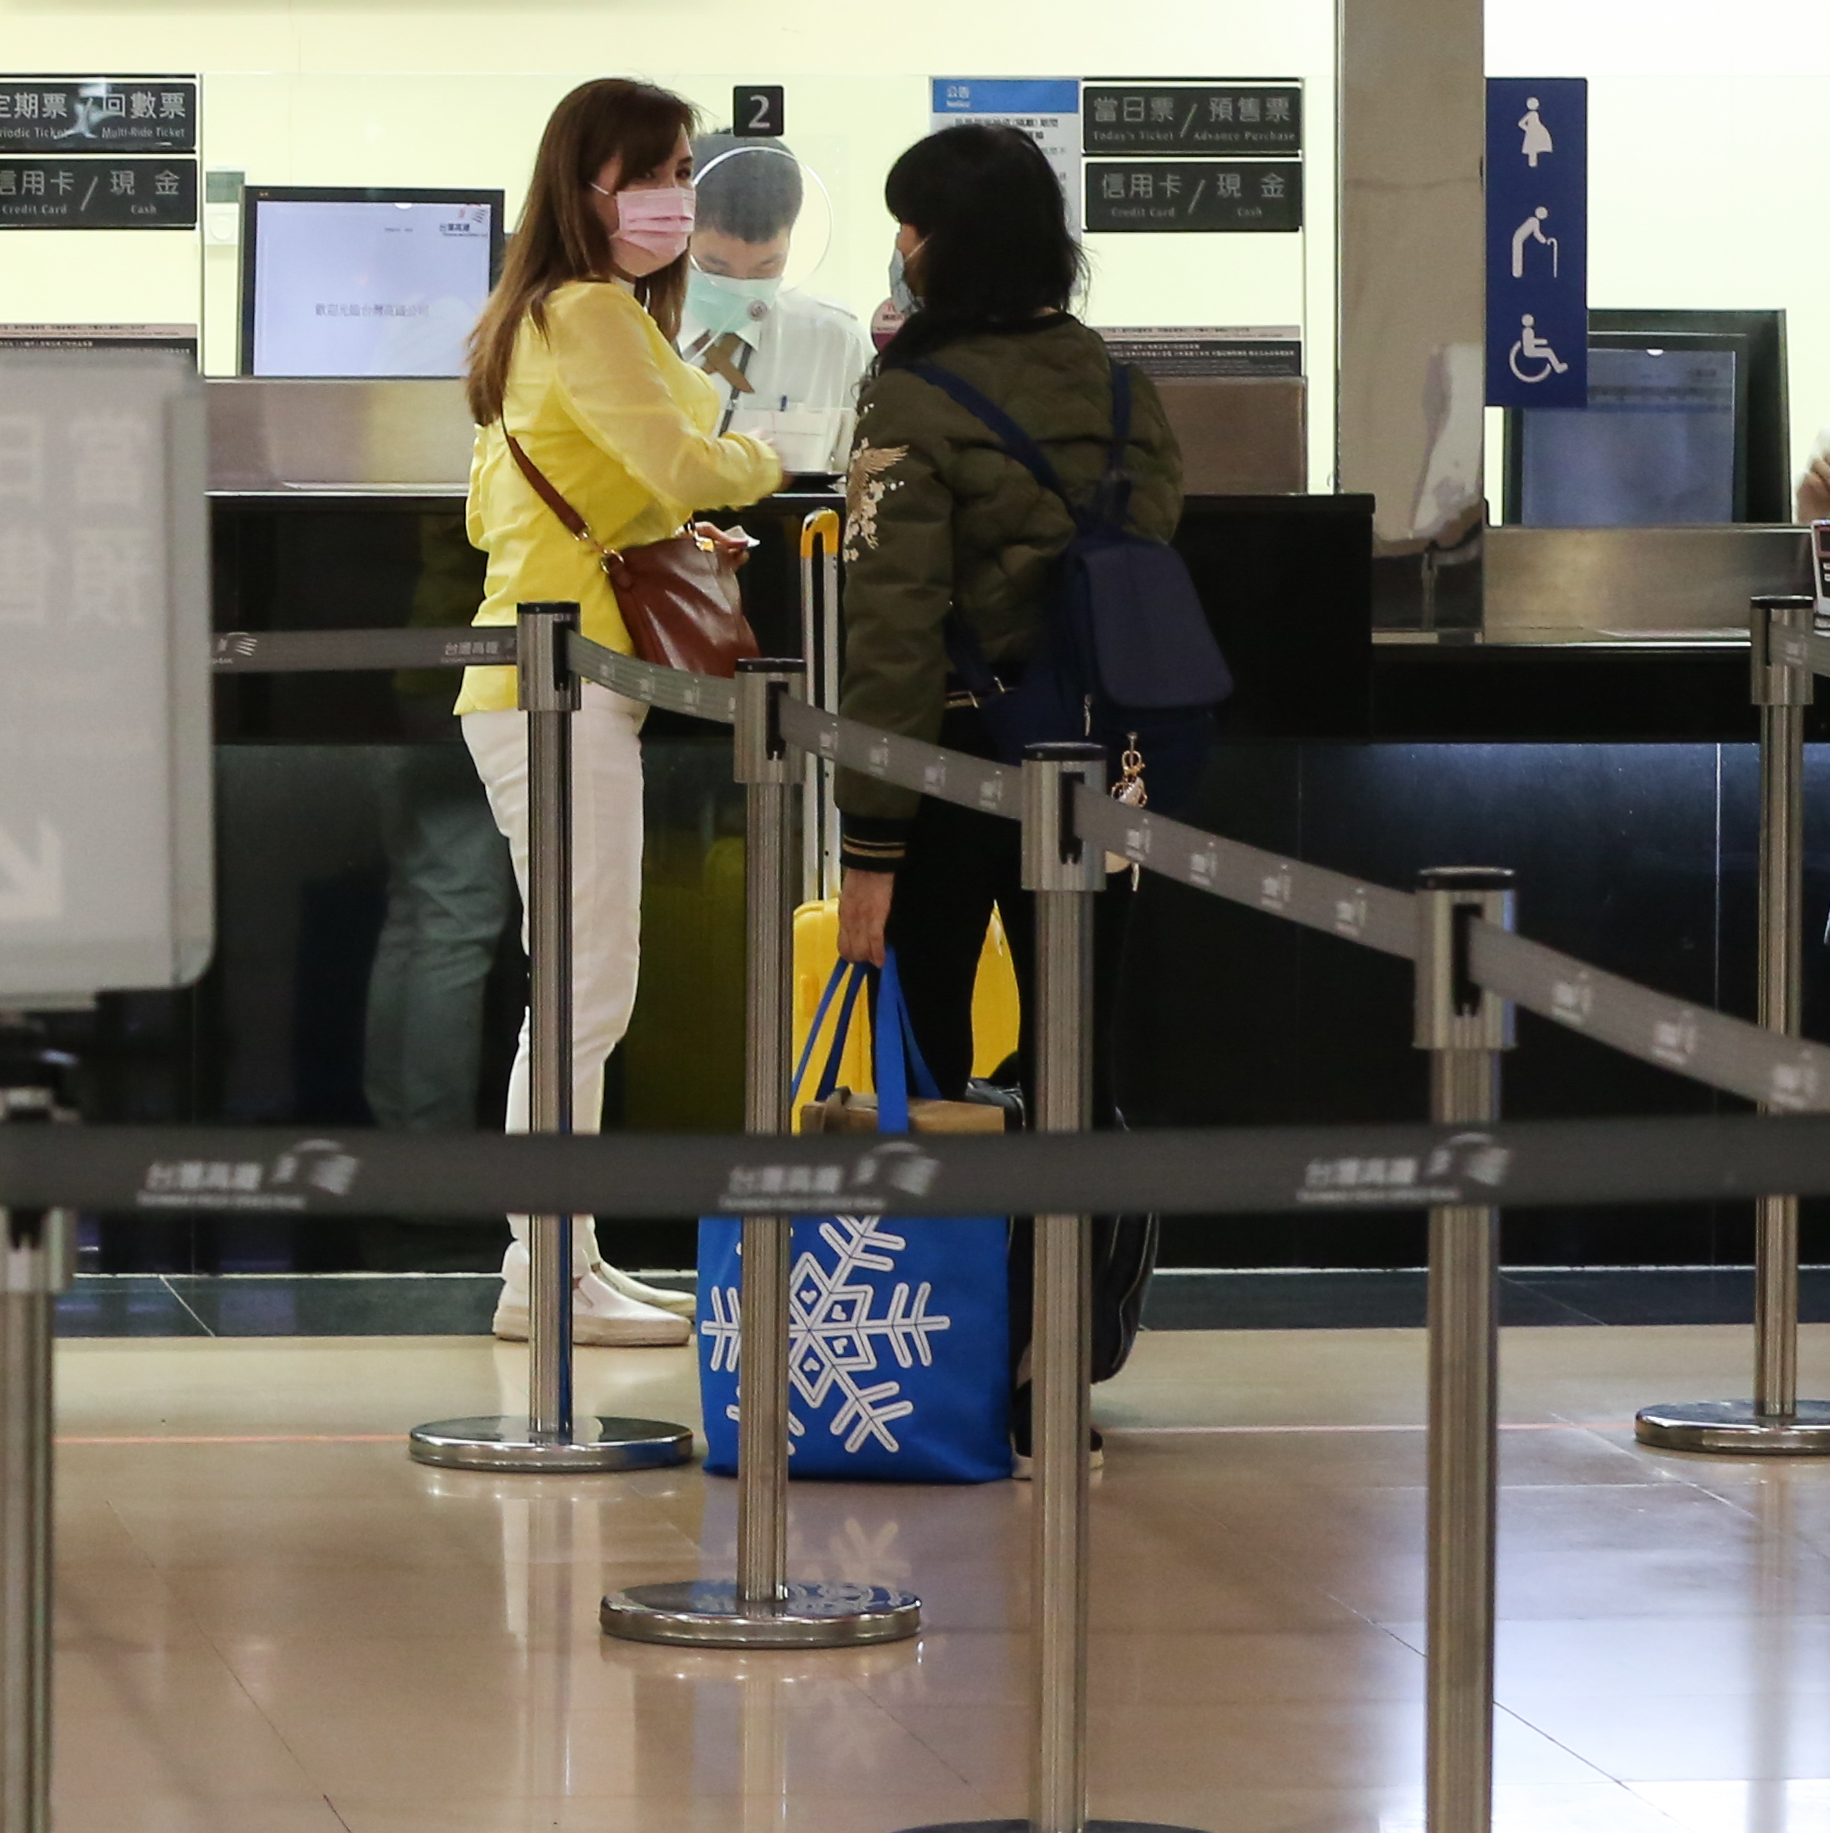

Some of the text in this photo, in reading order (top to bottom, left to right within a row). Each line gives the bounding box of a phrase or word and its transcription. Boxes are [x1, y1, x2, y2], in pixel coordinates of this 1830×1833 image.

[101, 91, 187, 120] 回數票
[749, 95, 770, 128] 2
